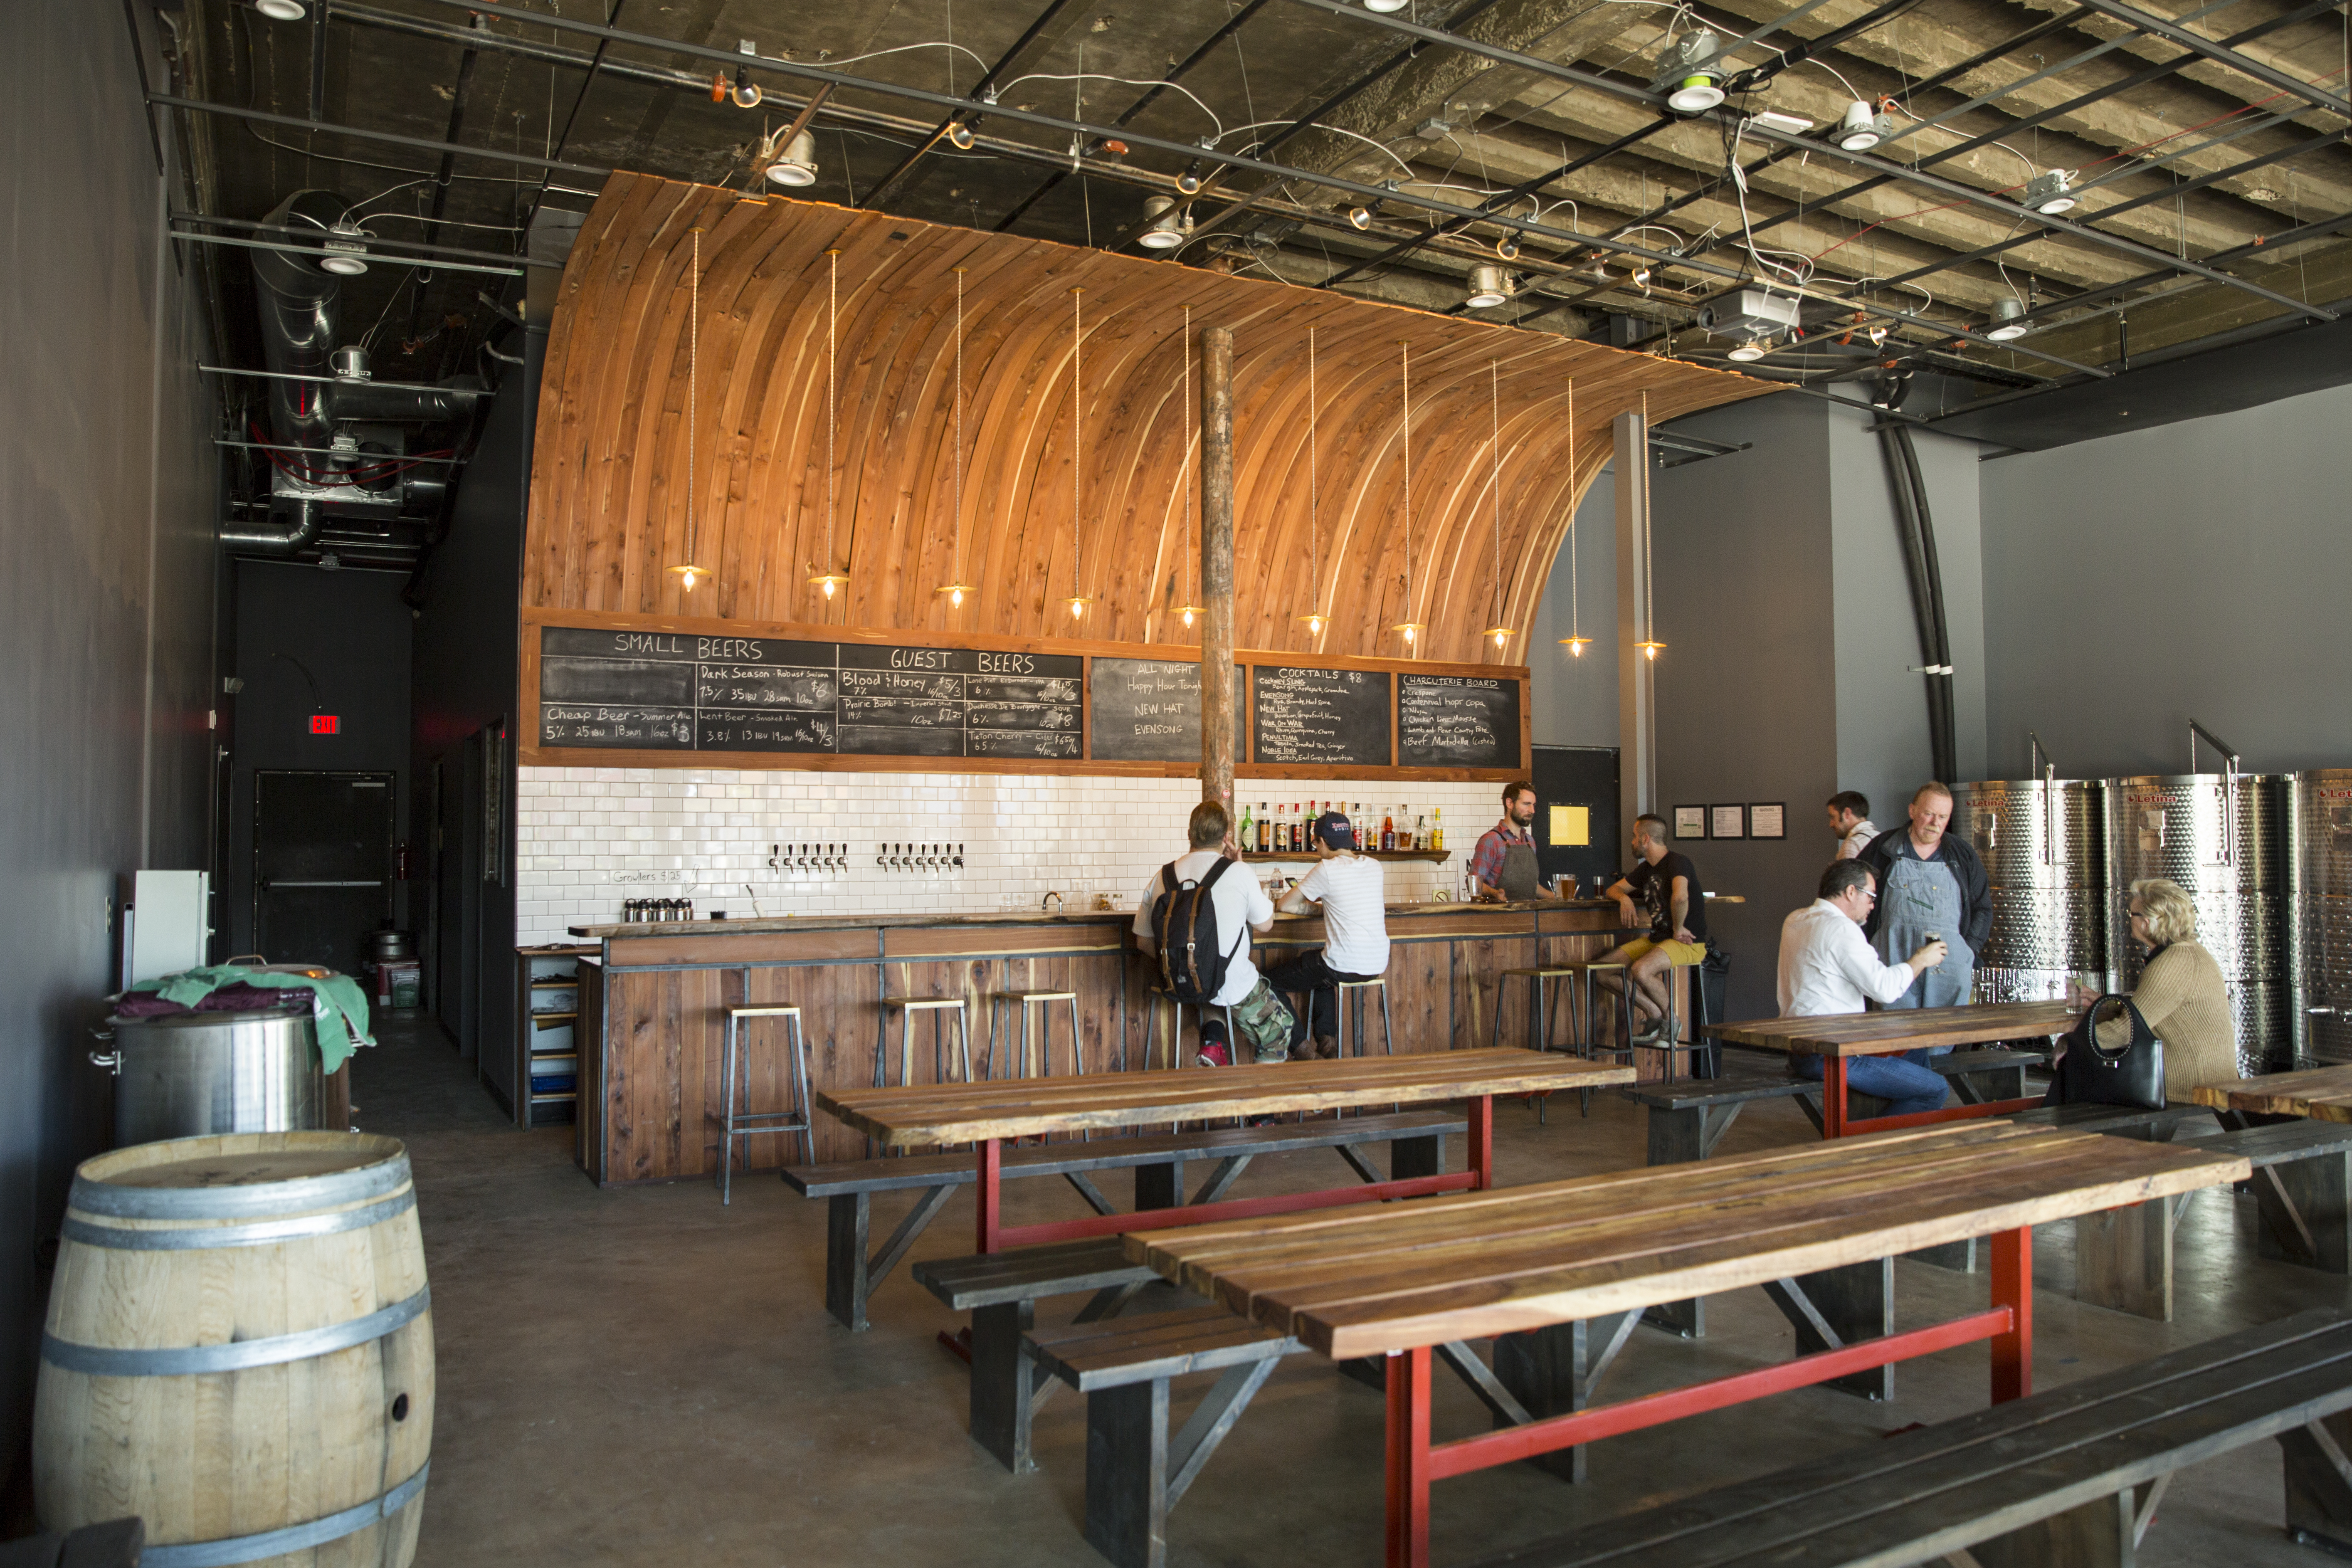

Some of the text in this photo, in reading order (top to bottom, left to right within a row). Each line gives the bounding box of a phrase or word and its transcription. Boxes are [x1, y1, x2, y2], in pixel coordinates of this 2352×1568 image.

[615, 635, 762, 659] SMALL BEERS
[891, 649, 1034, 674] GUEST BEERS
[701, 666, 728, 679] Dark
[732, 667, 769, 678] Season
[777, 669, 803, 677] Robust
[1137, 664, 1195, 675] ALL NIGHT
[843, 672, 881, 686] Blood
[894, 673, 925, 691] Honey
[1278, 668, 1362, 684] COCKTAILS $8
[1403, 675, 1498, 687] CHARCUTERIE BOARD
[699, 686, 723, 701] 7.5%
[811, 679, 827, 698] $6
[854, 687, 867, 695] 7%
[1127, 676, 1202, 696] Happy Hour Tonigh
[843, 699, 871, 709] Prairie
[873, 699, 896, 707] Bomb!
[967, 702, 998, 711] Duchesse
[1011, 704, 1041, 712] Bourgogne
[1445, 697, 1463, 708] hops
[548, 708, 591, 722] Cheap
[597, 708, 629, 721] Beer
[641, 711, 675, 721] Summer
[677, 711, 692, 720] Ale
[848, 711, 861, 720] 14%
[1135, 703, 1184, 717] NEW HAT
[700, 711, 722, 720] Lent
[725, 712, 747, 721] Beer
[972, 713, 989, 724] 6%
[1058, 712, 1073, 727] $8
[1325, 712, 1341, 721] Honey
[1409, 715, 1434, 724] Chicken
[313, 716, 337, 733] EXIT
[1135, 724, 1183, 735] EVENSONG
[546, 726, 565, 740] 5%
[671, 720, 689, 743] $3
[707, 729, 731, 742] 3.8%
[995, 732, 1022, 742] Cherry
[1035, 732, 1053, 741] Cider
[1262, 733, 1298, 741] PENULTIMA
[1408, 734, 1428, 746] Beef
[1432, 735, 1469, 746] Mortadella
[1327, 742, 1345, 752] Ginger
[2137, 794, 2176, 803] Letina
[2330, 789, 2352, 798] Let
[613, 872, 656, 882] Growlers
